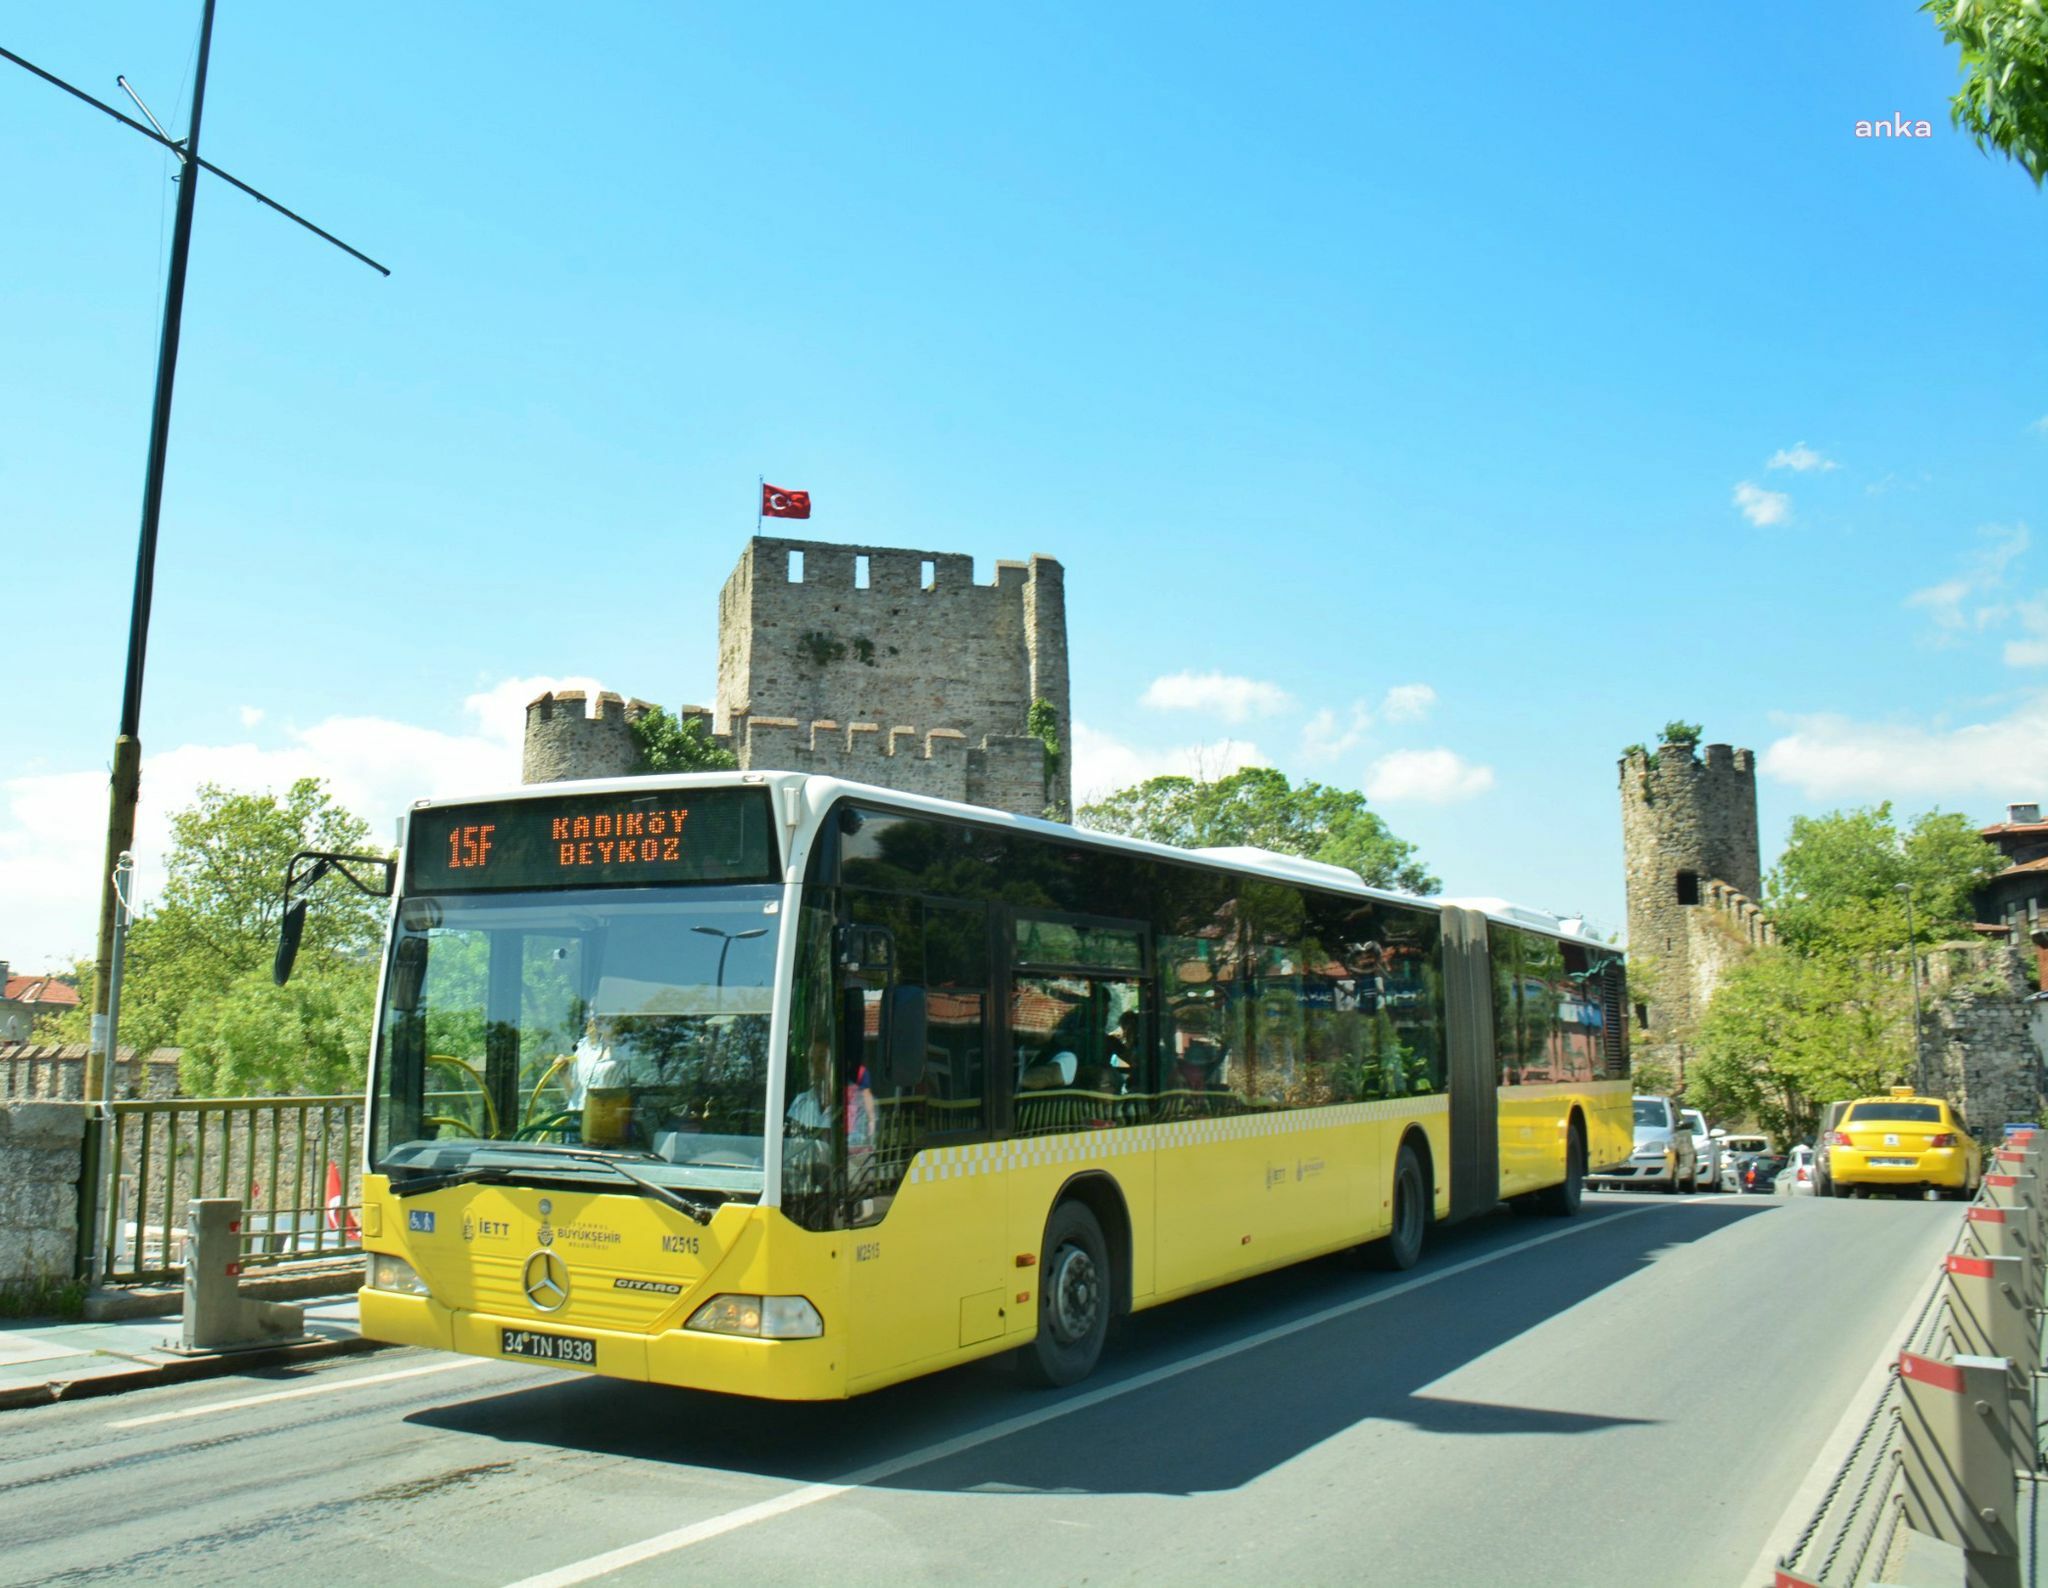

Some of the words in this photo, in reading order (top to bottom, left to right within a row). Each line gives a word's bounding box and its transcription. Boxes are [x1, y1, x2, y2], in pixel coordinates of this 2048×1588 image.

[448, 824, 496, 868] 15F
[560, 838, 680, 866] BEYKOZ
[662, 1235, 700, 1255] M2515
[615, 1279, 680, 1294] CITARO
[504, 1331, 524, 1353] 34
[531, 1334, 553, 1357] TN
[557, 1338, 593, 1362] 1938
